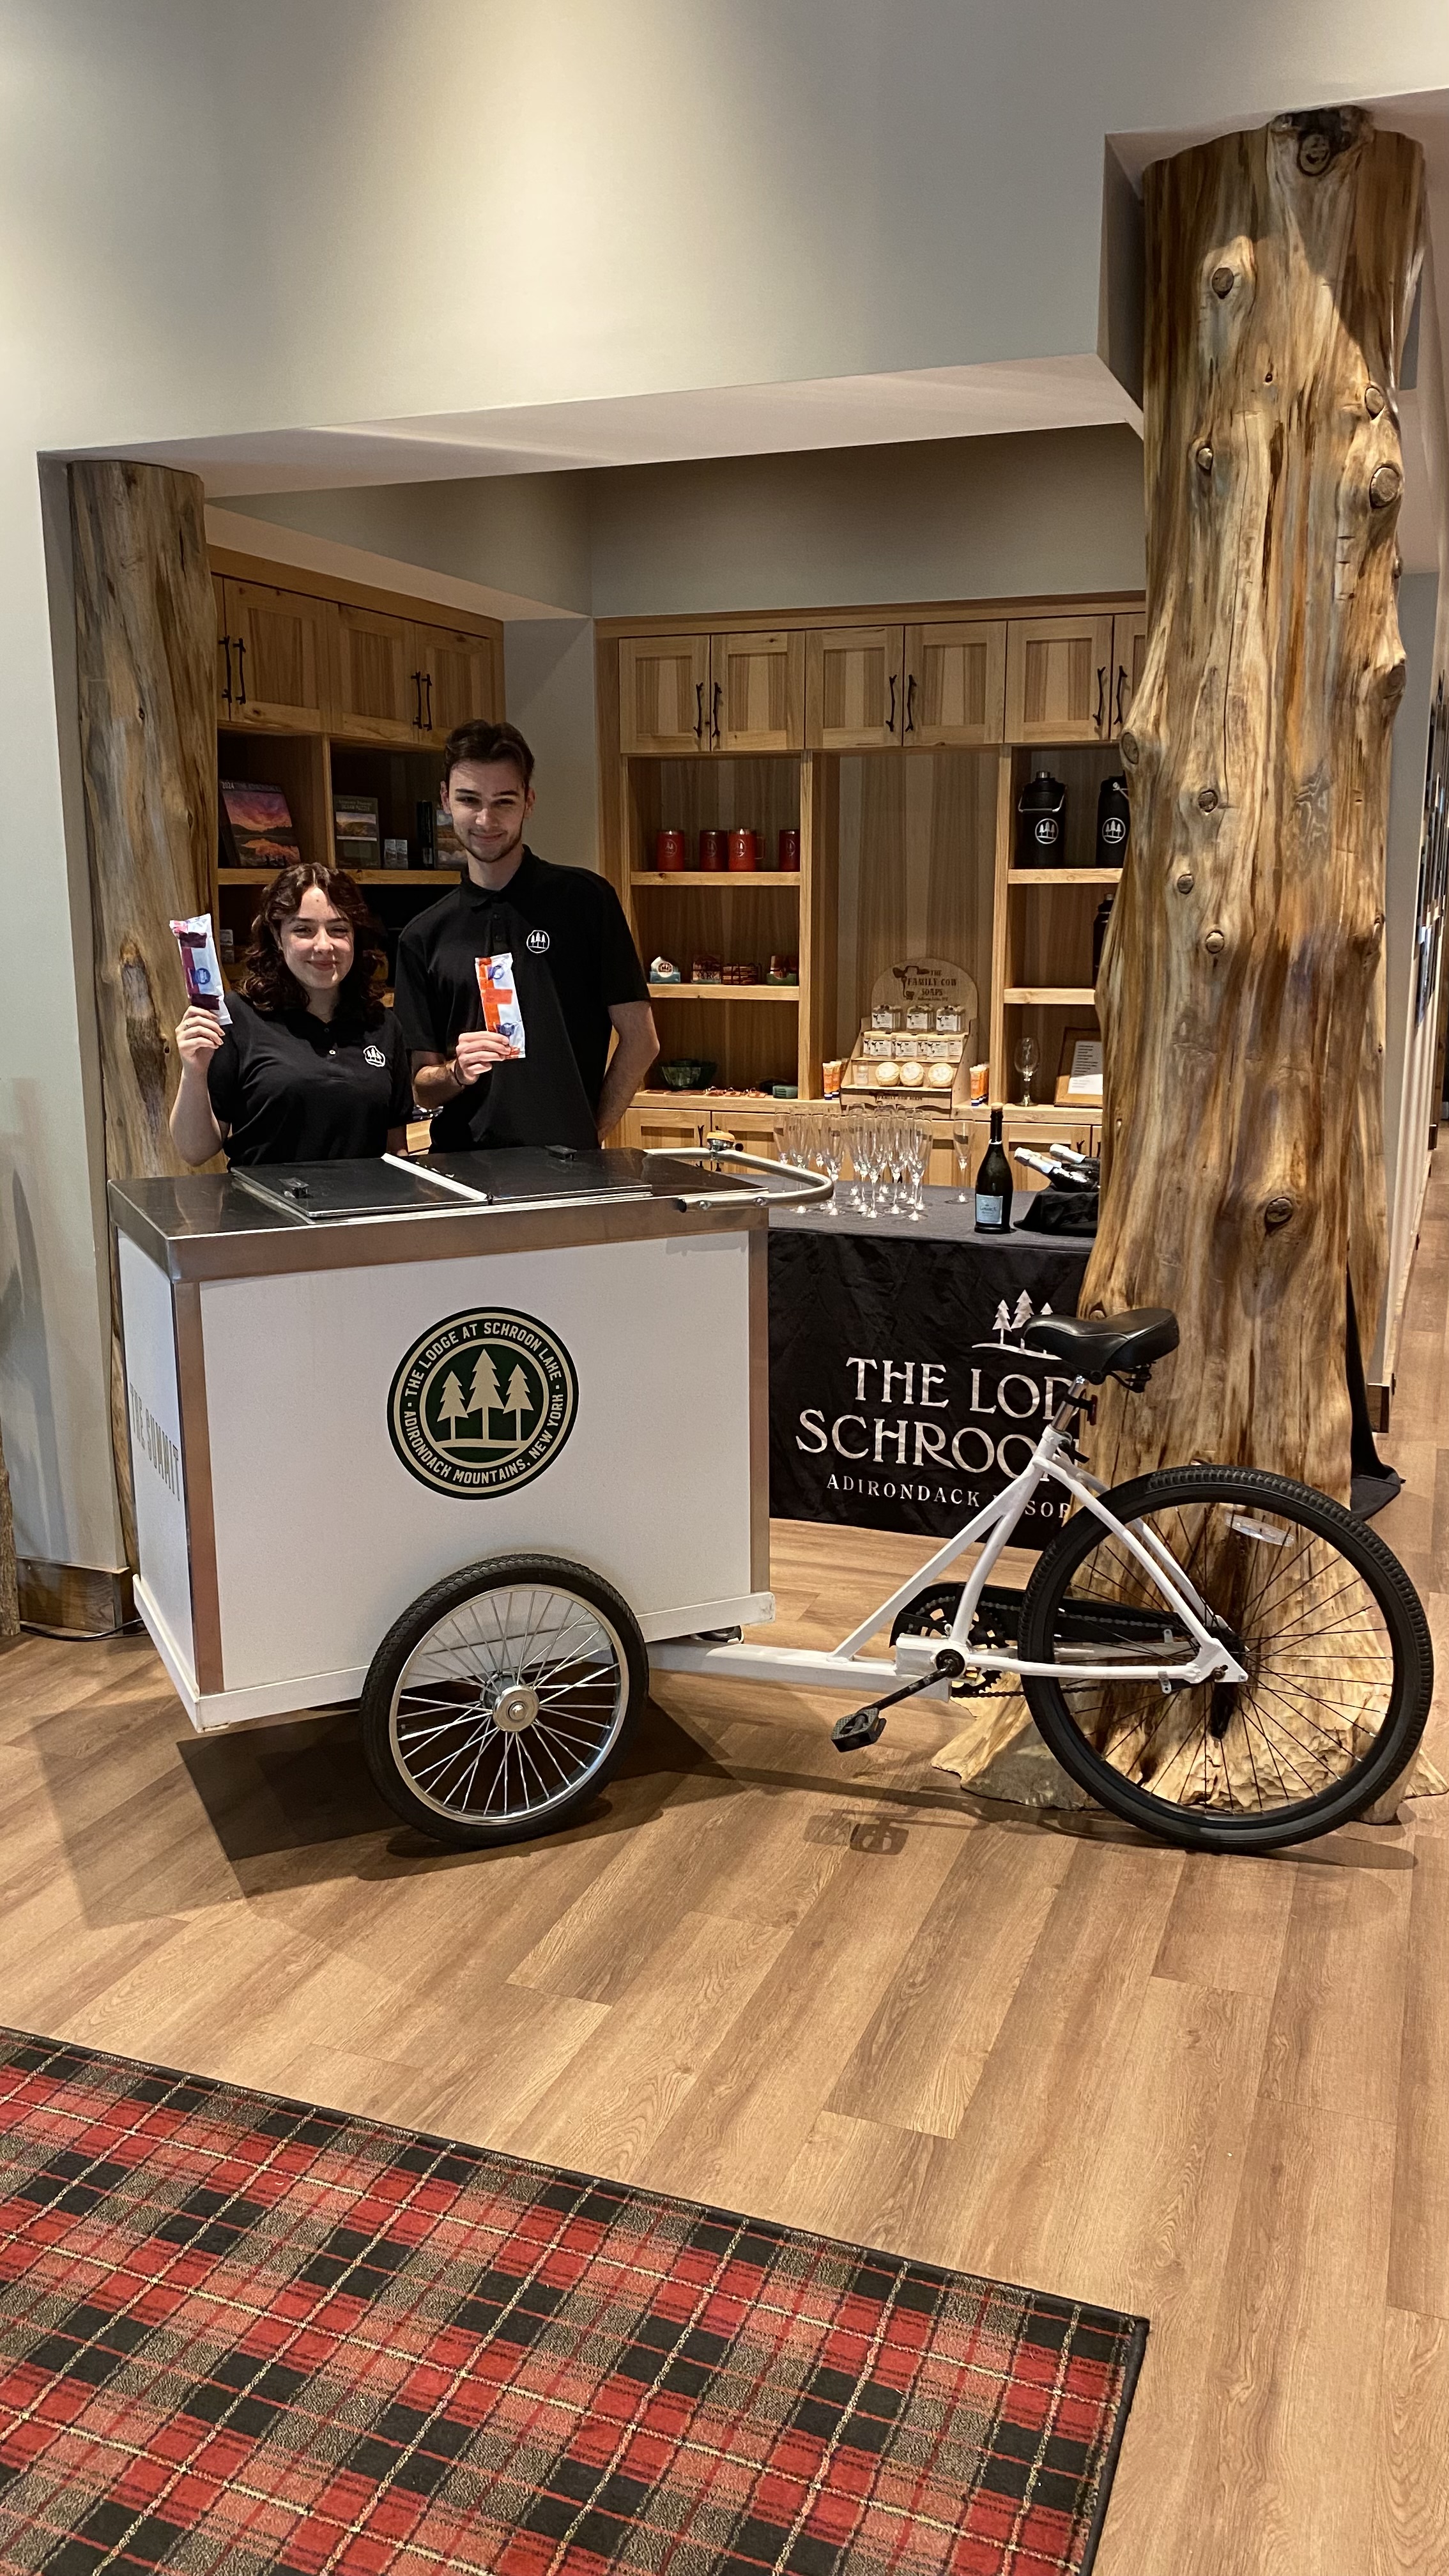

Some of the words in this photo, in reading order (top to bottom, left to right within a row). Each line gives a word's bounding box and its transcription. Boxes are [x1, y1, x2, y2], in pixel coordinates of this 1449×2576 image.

[907, 977, 937, 986] FAMILY
[404, 1370, 424, 1397] THE
[418, 1331, 459, 1368] LODGE
[463, 1323, 478, 1339] AT
[484, 1322, 542, 1352] SCHROON
[538, 1347, 562, 1381] LAKE
[845, 1356, 949, 1408] THE
[969, 1368, 1080, 1420] LOD
[129, 1382, 145, 1450] THE
[404, 1411, 452, 1478] ADIRONDACK
[452, 1459, 530, 1484] MOUNTAINS,
[528, 1429, 553, 1459] NEW
[547, 1393, 564, 1427] YORK
[826, 1474, 980, 1508] ADIRONDACK
